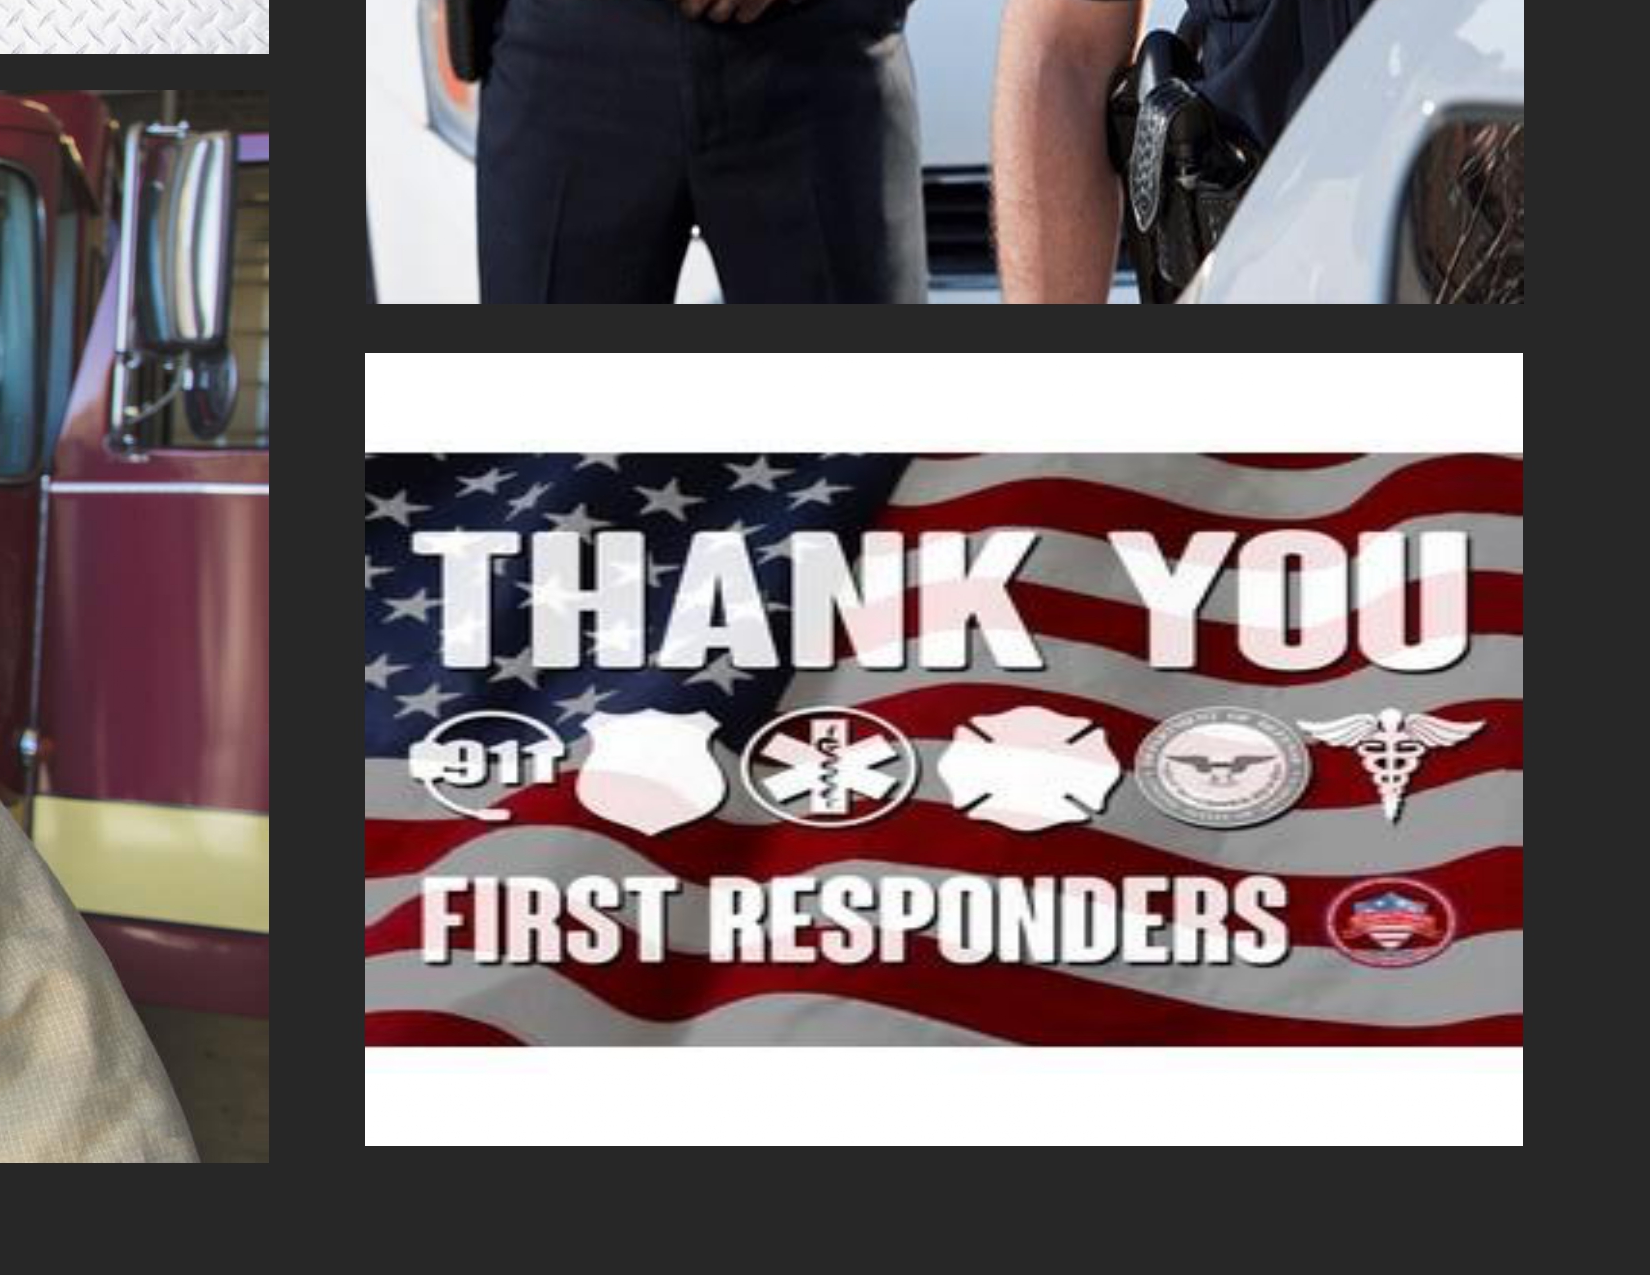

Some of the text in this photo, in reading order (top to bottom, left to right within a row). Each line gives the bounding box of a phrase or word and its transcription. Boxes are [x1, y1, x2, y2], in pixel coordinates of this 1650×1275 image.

[412, 530, 1470, 672] THANK YOU
[422, 875, 1290, 966] FIRST RESPONDERS
